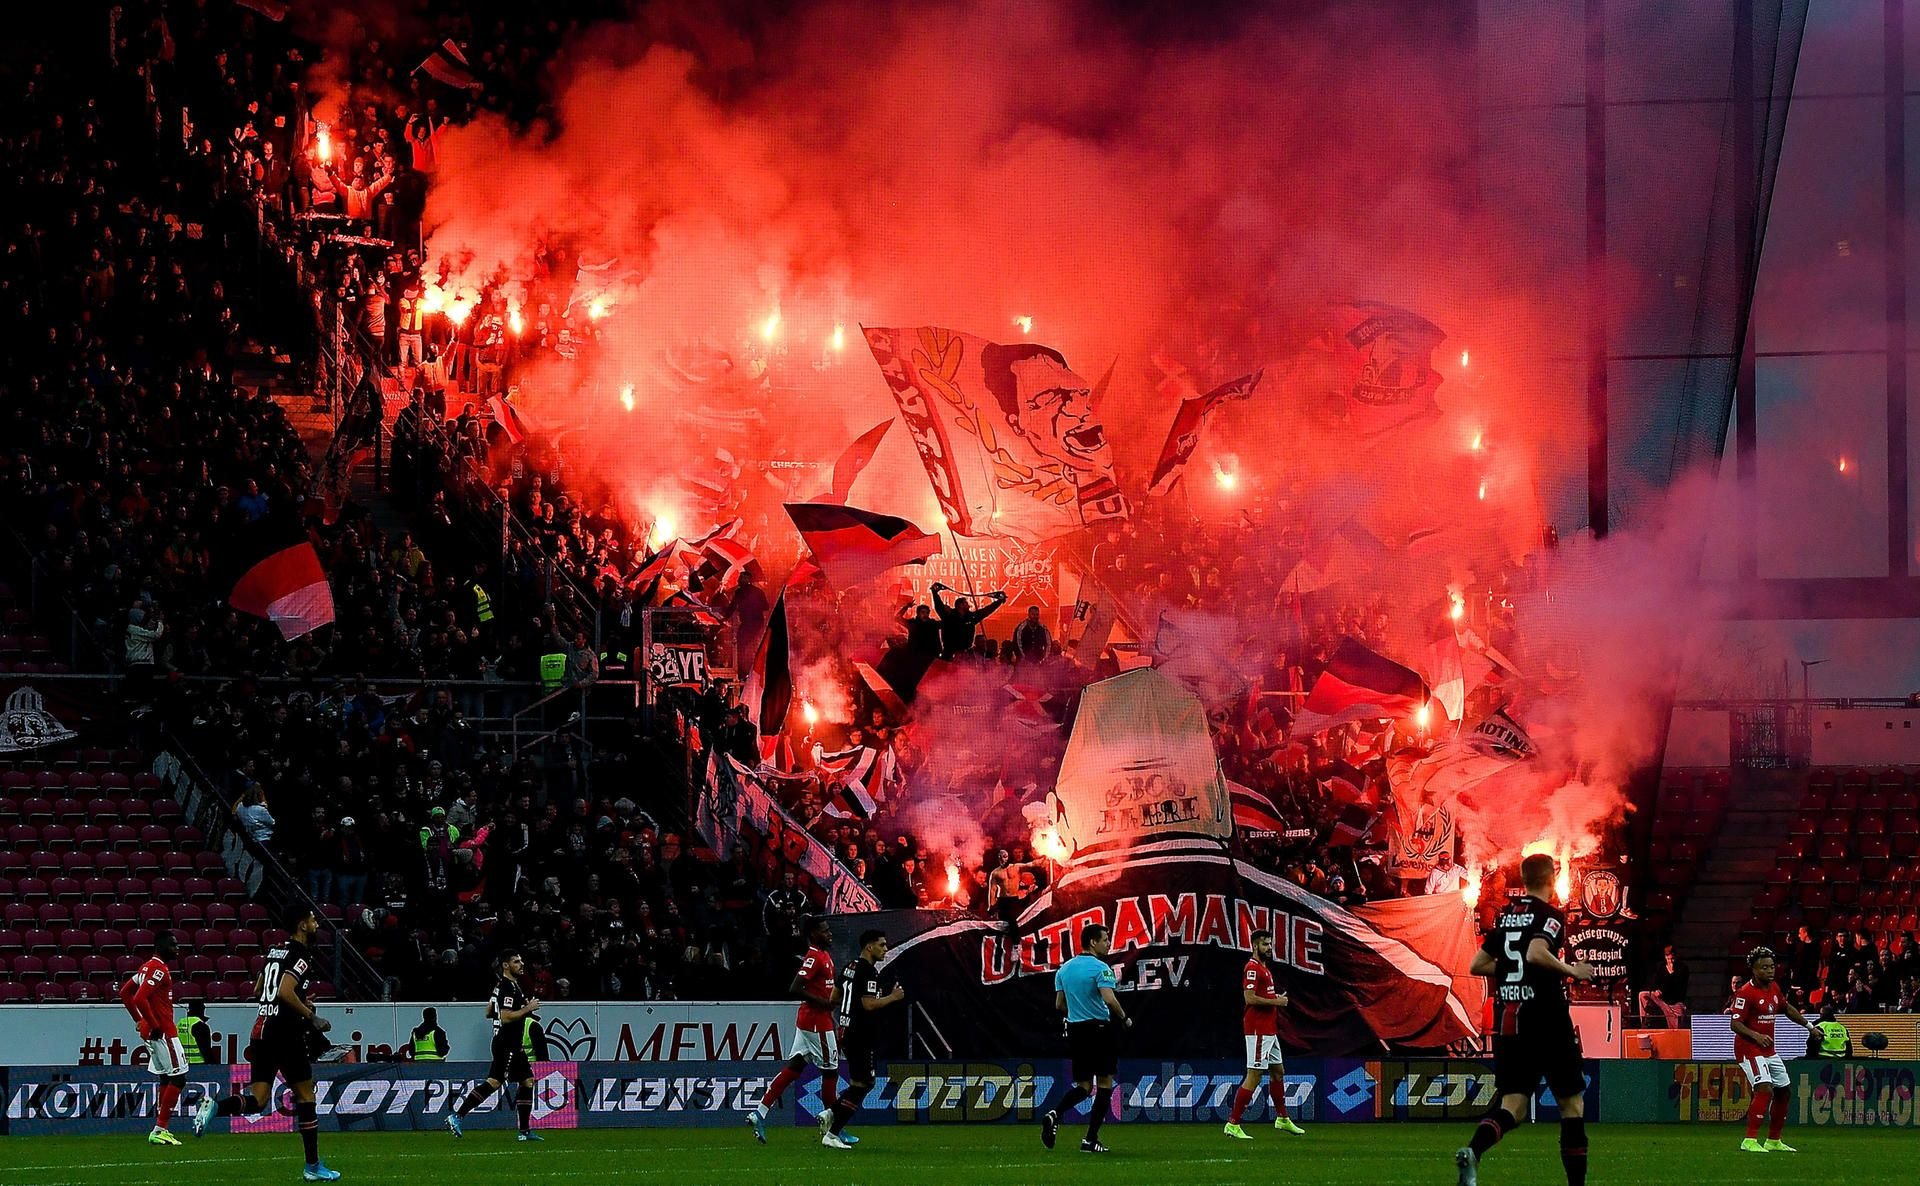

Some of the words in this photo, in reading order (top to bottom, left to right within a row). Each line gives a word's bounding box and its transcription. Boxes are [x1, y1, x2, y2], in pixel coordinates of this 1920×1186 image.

[980, 892, 1325, 986] ULTRAMANIE
[1503, 931, 1524, 983] 5
[259, 961, 280, 1002] 10
[840, 979, 853, 1015] 11
[614, 1022, 784, 1062] MEWA
